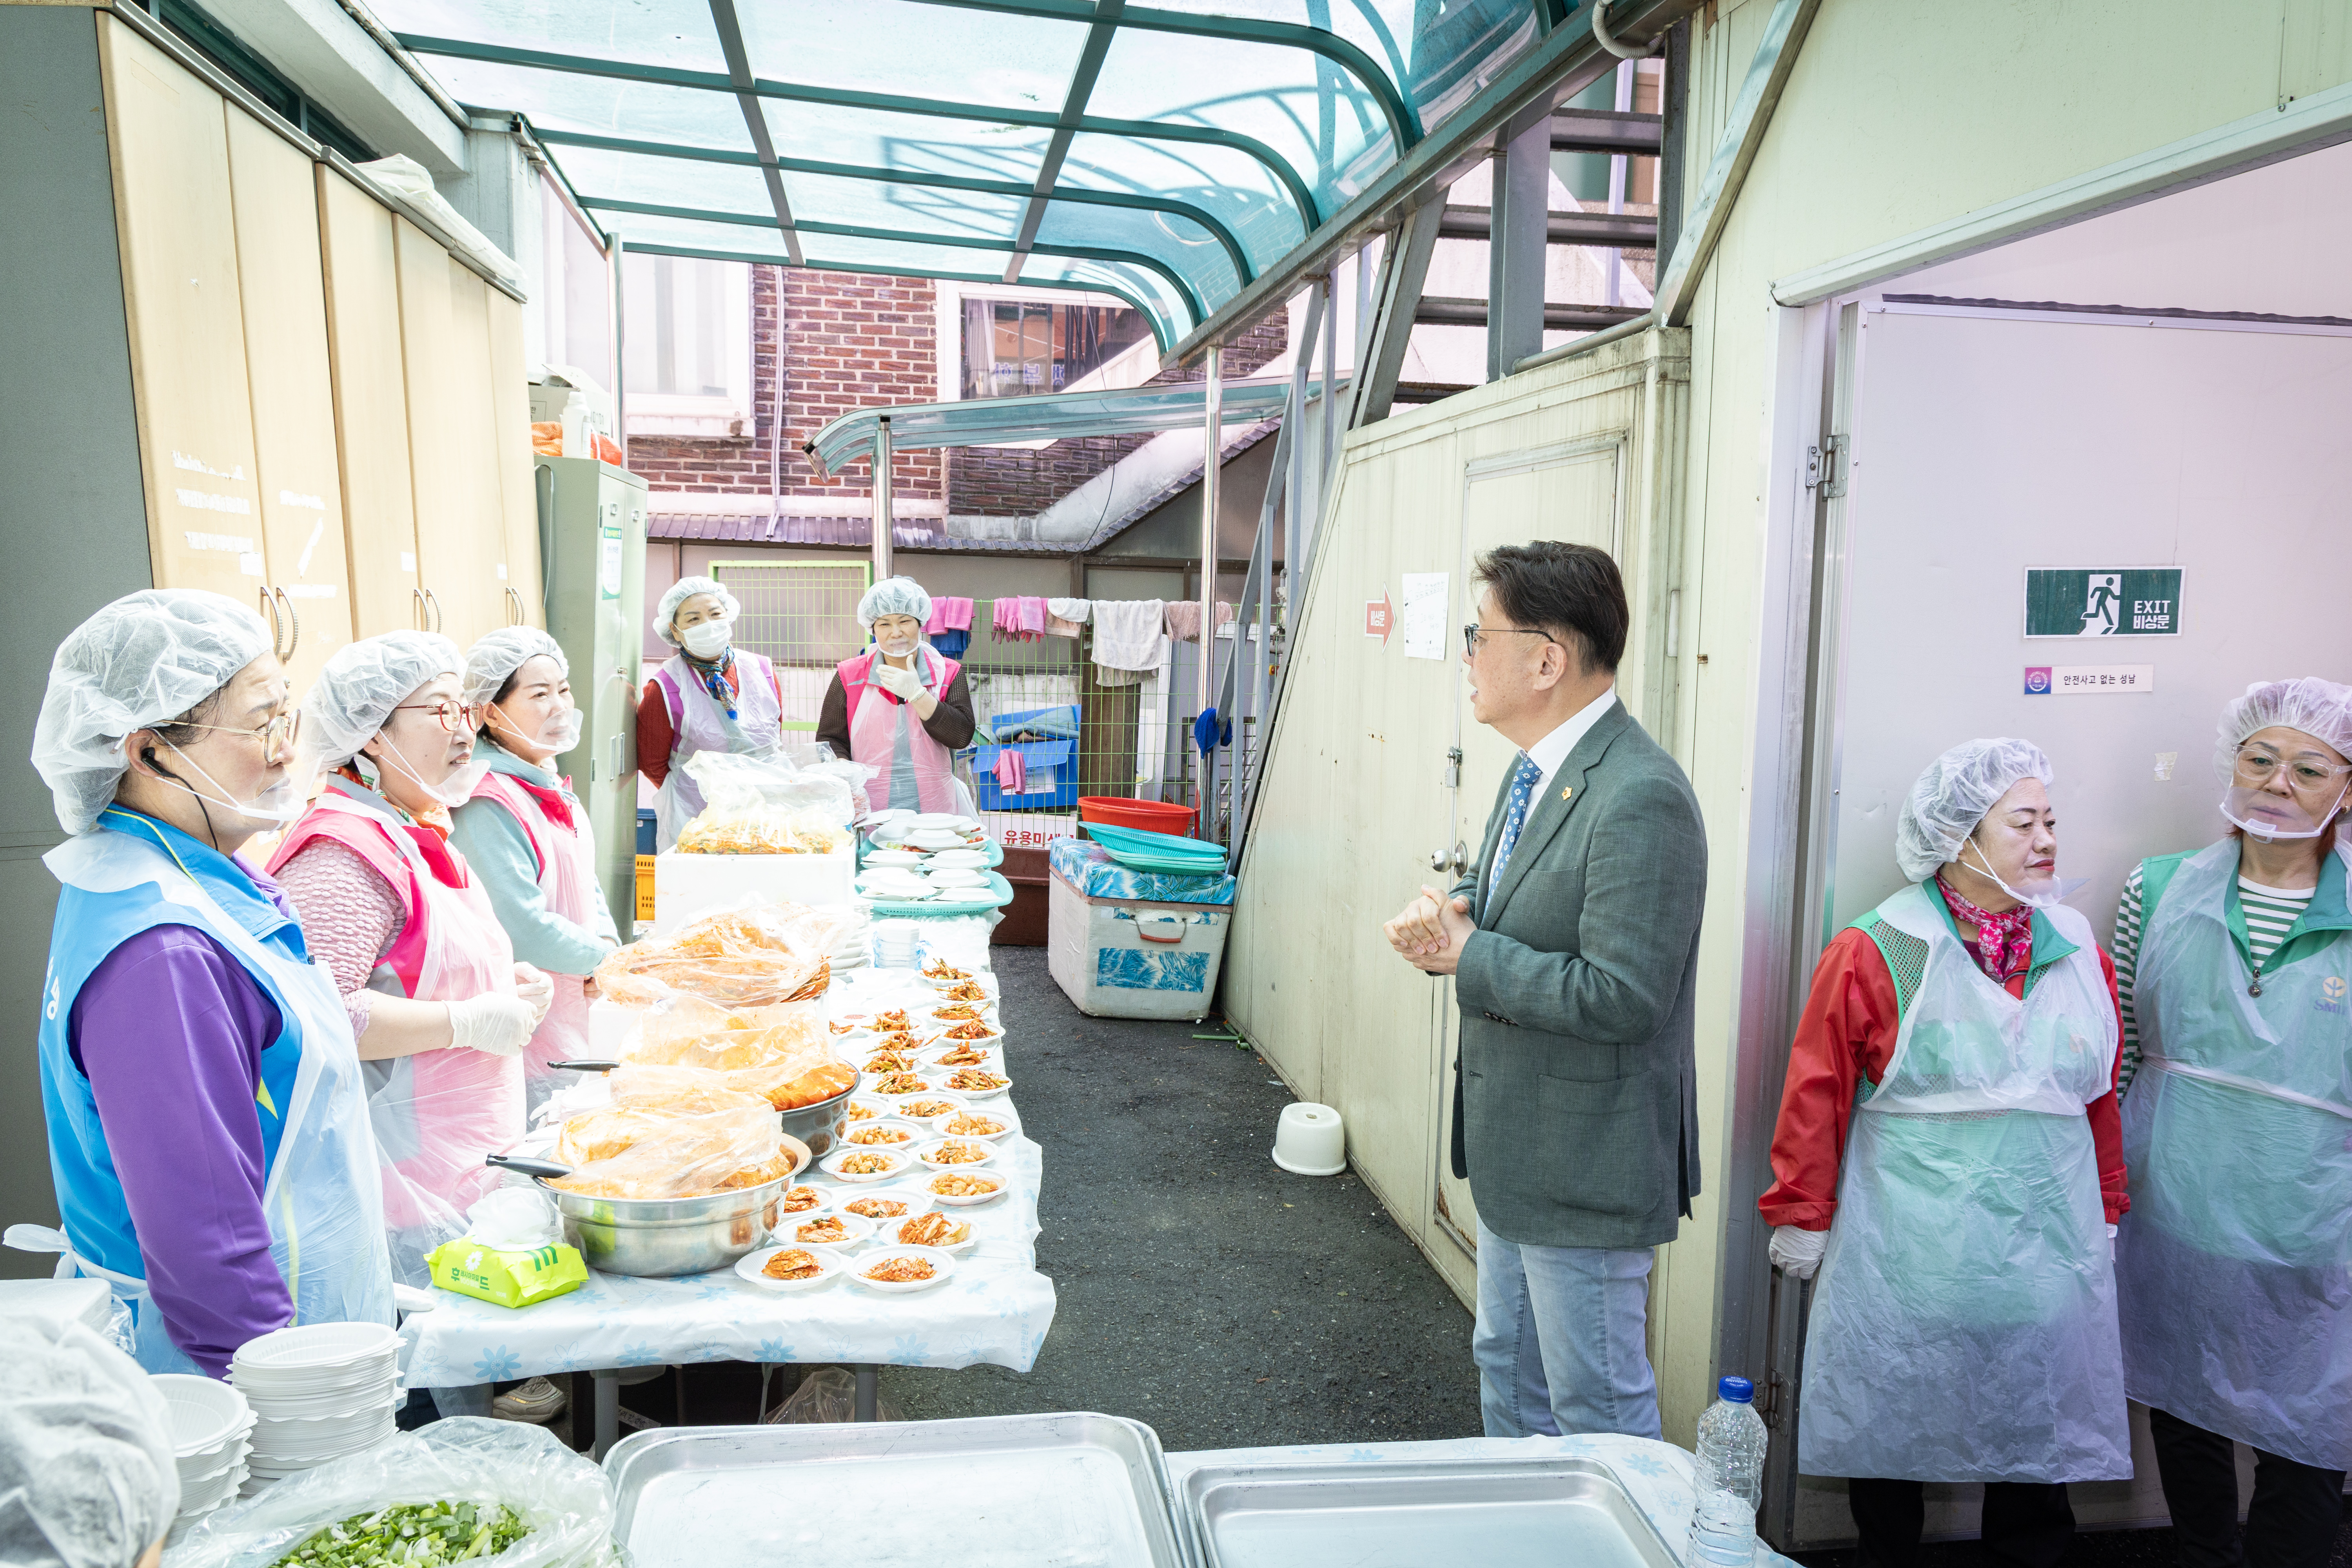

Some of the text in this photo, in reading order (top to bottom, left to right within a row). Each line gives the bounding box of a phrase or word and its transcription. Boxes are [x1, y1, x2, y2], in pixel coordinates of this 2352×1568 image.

[2134, 600, 2171, 613] EXIT
[1370, 610, 1385, 627] 비상문
[2133, 615, 2169, 629] 비상문
[2063, 674, 2136, 685] 안전사고 없는 성남
